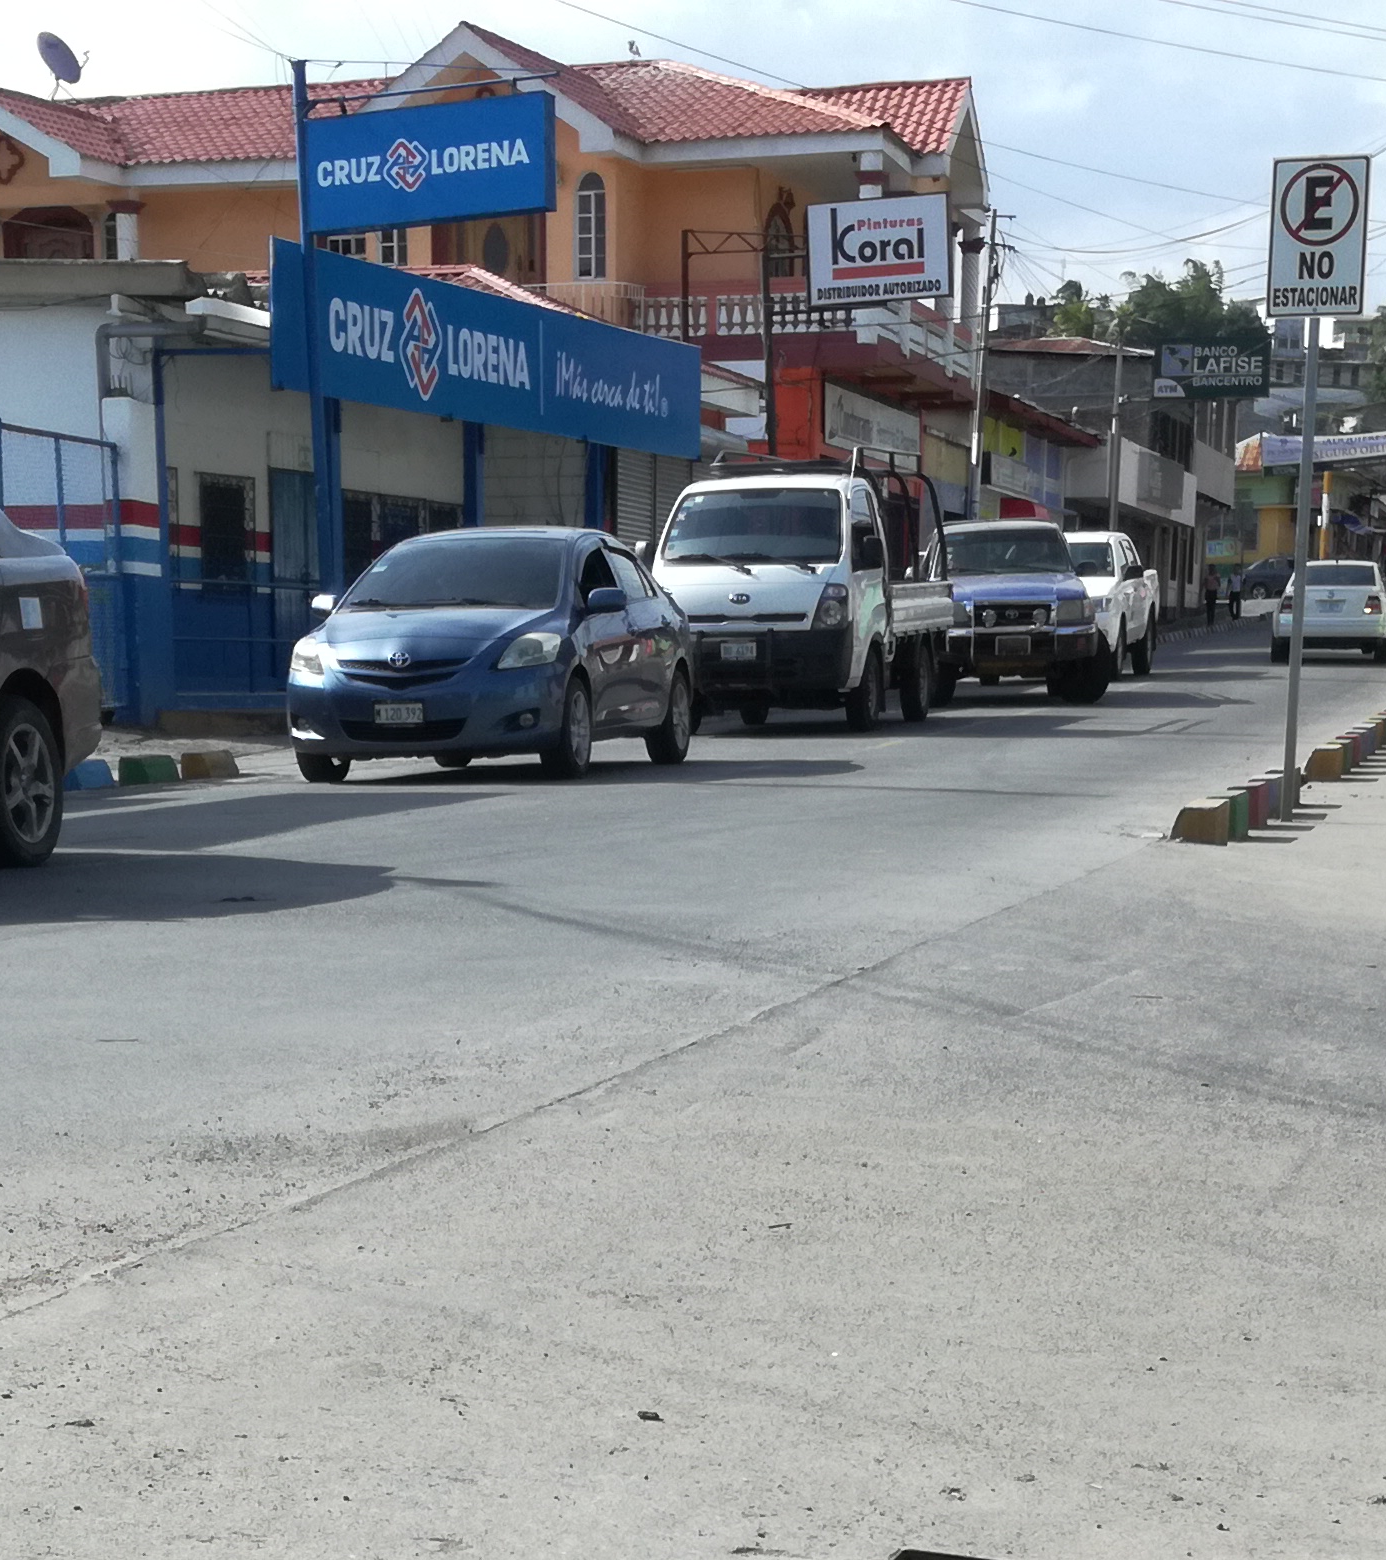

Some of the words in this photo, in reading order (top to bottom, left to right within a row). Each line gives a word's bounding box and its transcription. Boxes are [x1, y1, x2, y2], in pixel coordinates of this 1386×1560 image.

[317, 155, 381, 187] CRUZ
[431, 138, 530, 175] LORENA
[857, 217, 924, 231] Pinturas
[830, 208, 925, 265] Koral
[1298, 251, 1335, 280] NO
[817, 283, 880, 300] DISTRIBUIDOR
[882, 279, 942, 296] AUTORIZADO
[1272, 286, 1357, 308] ESTACIONAR
[328, 297, 394, 363] CRUZ
[447, 324, 531, 390] LORENA
[1194, 345, 1238, 357] BANCO
[1193, 356, 1263, 374] LAFISE
[1157, 384, 1178, 394] ATM
[1193, 375, 1263, 387] BANCENTRO
[590, 378, 623, 409] cerca
[626, 371, 642, 412] de
[1313, 446, 1357, 460] SEGURO
[385, 708, 402, 721] 120
